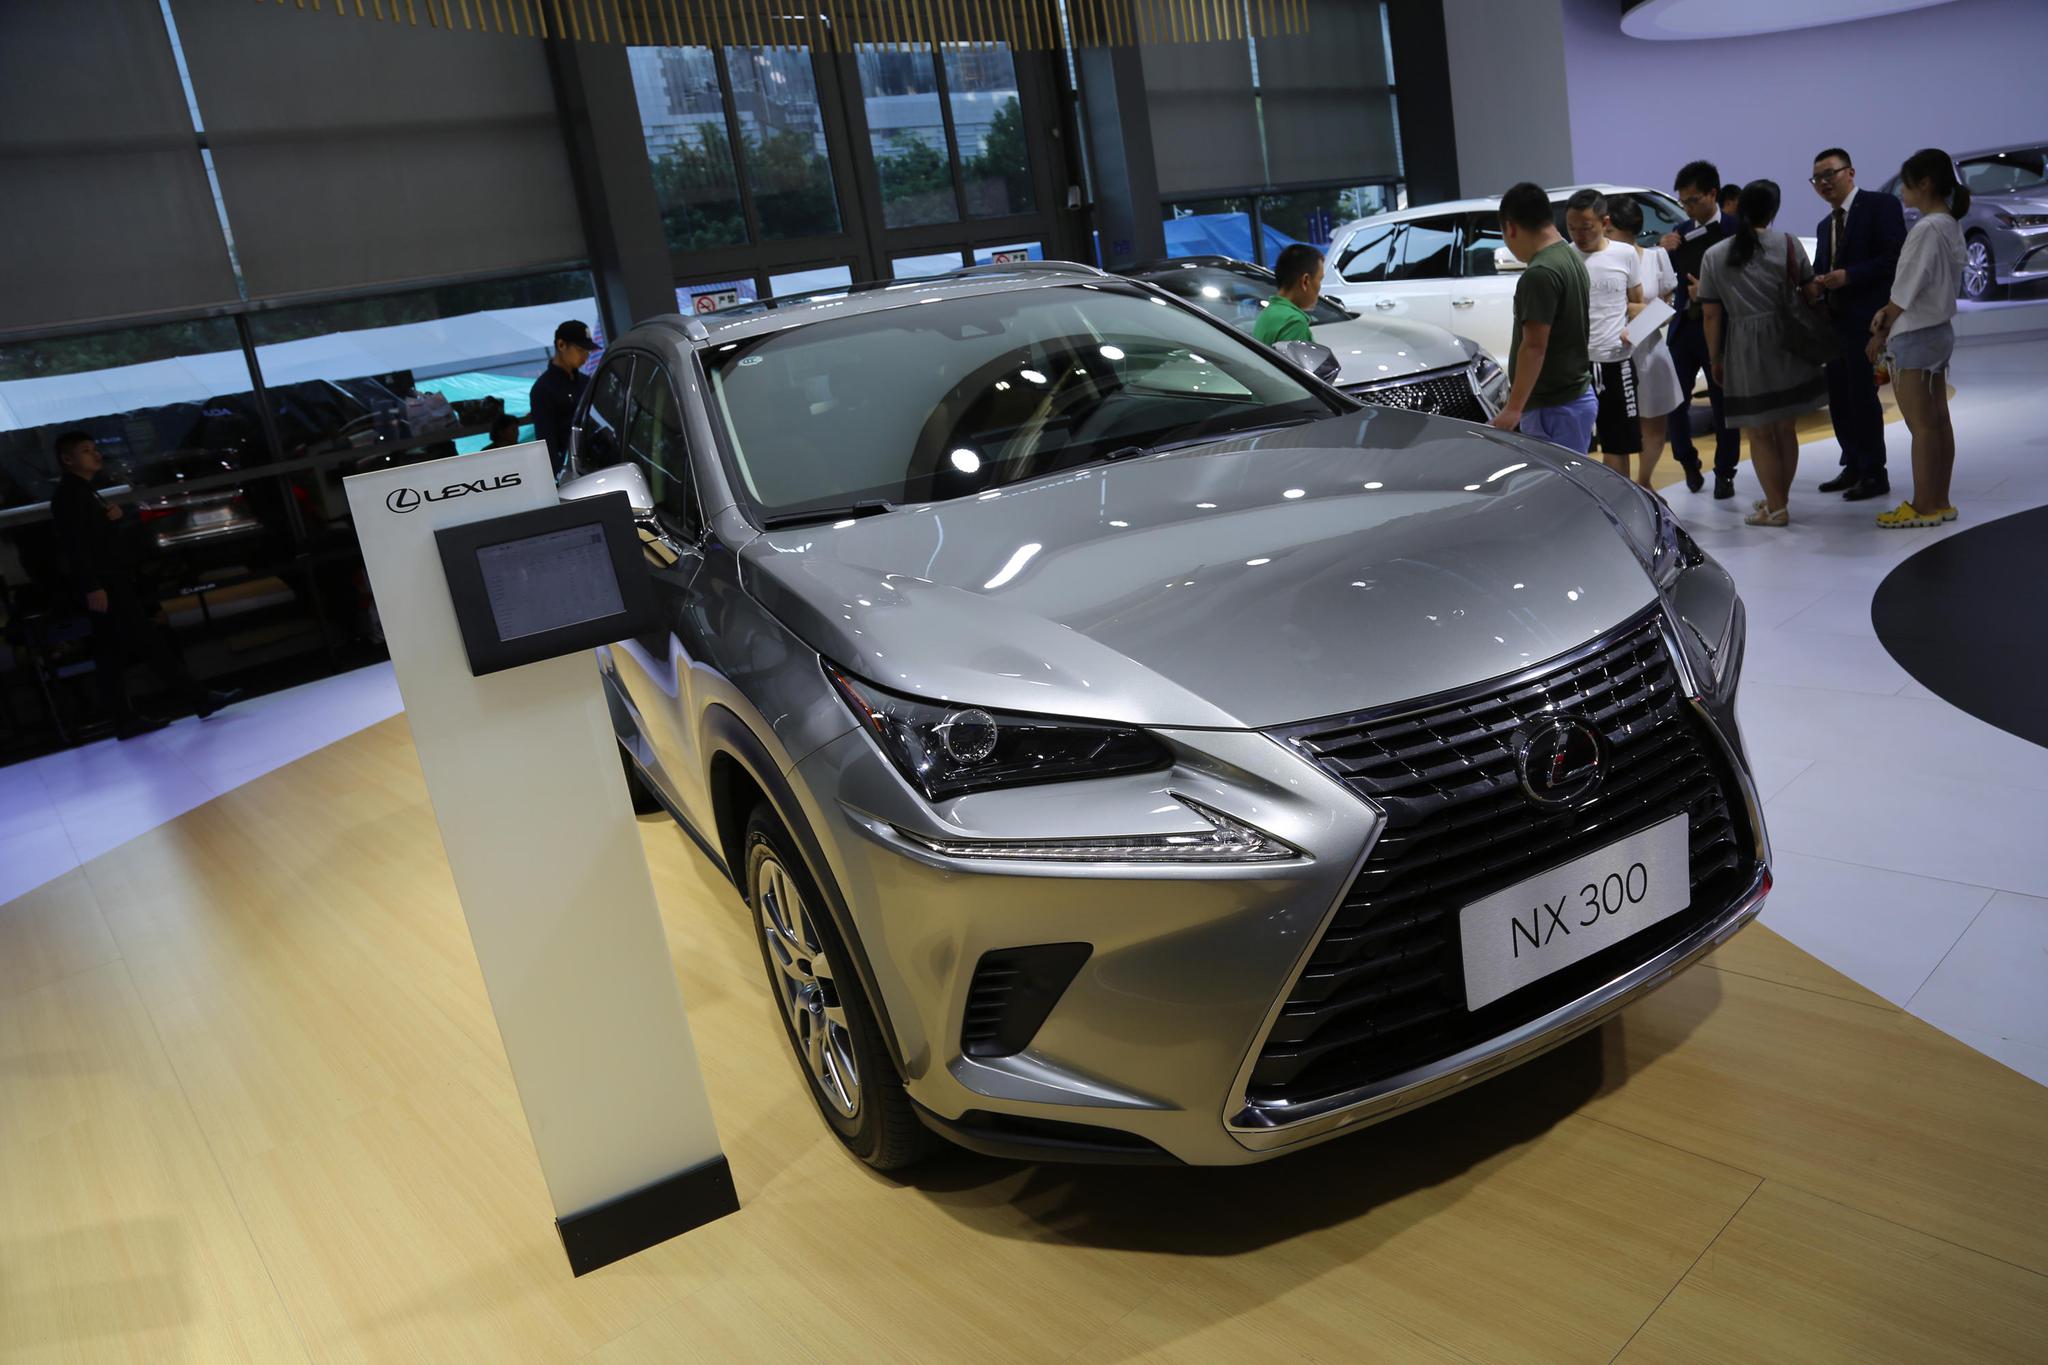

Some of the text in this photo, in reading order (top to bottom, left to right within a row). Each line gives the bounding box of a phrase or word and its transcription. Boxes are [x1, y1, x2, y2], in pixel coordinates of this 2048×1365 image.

[424, 473, 522, 502] LEXUS
[1511, 862, 1648, 958] NX 300
